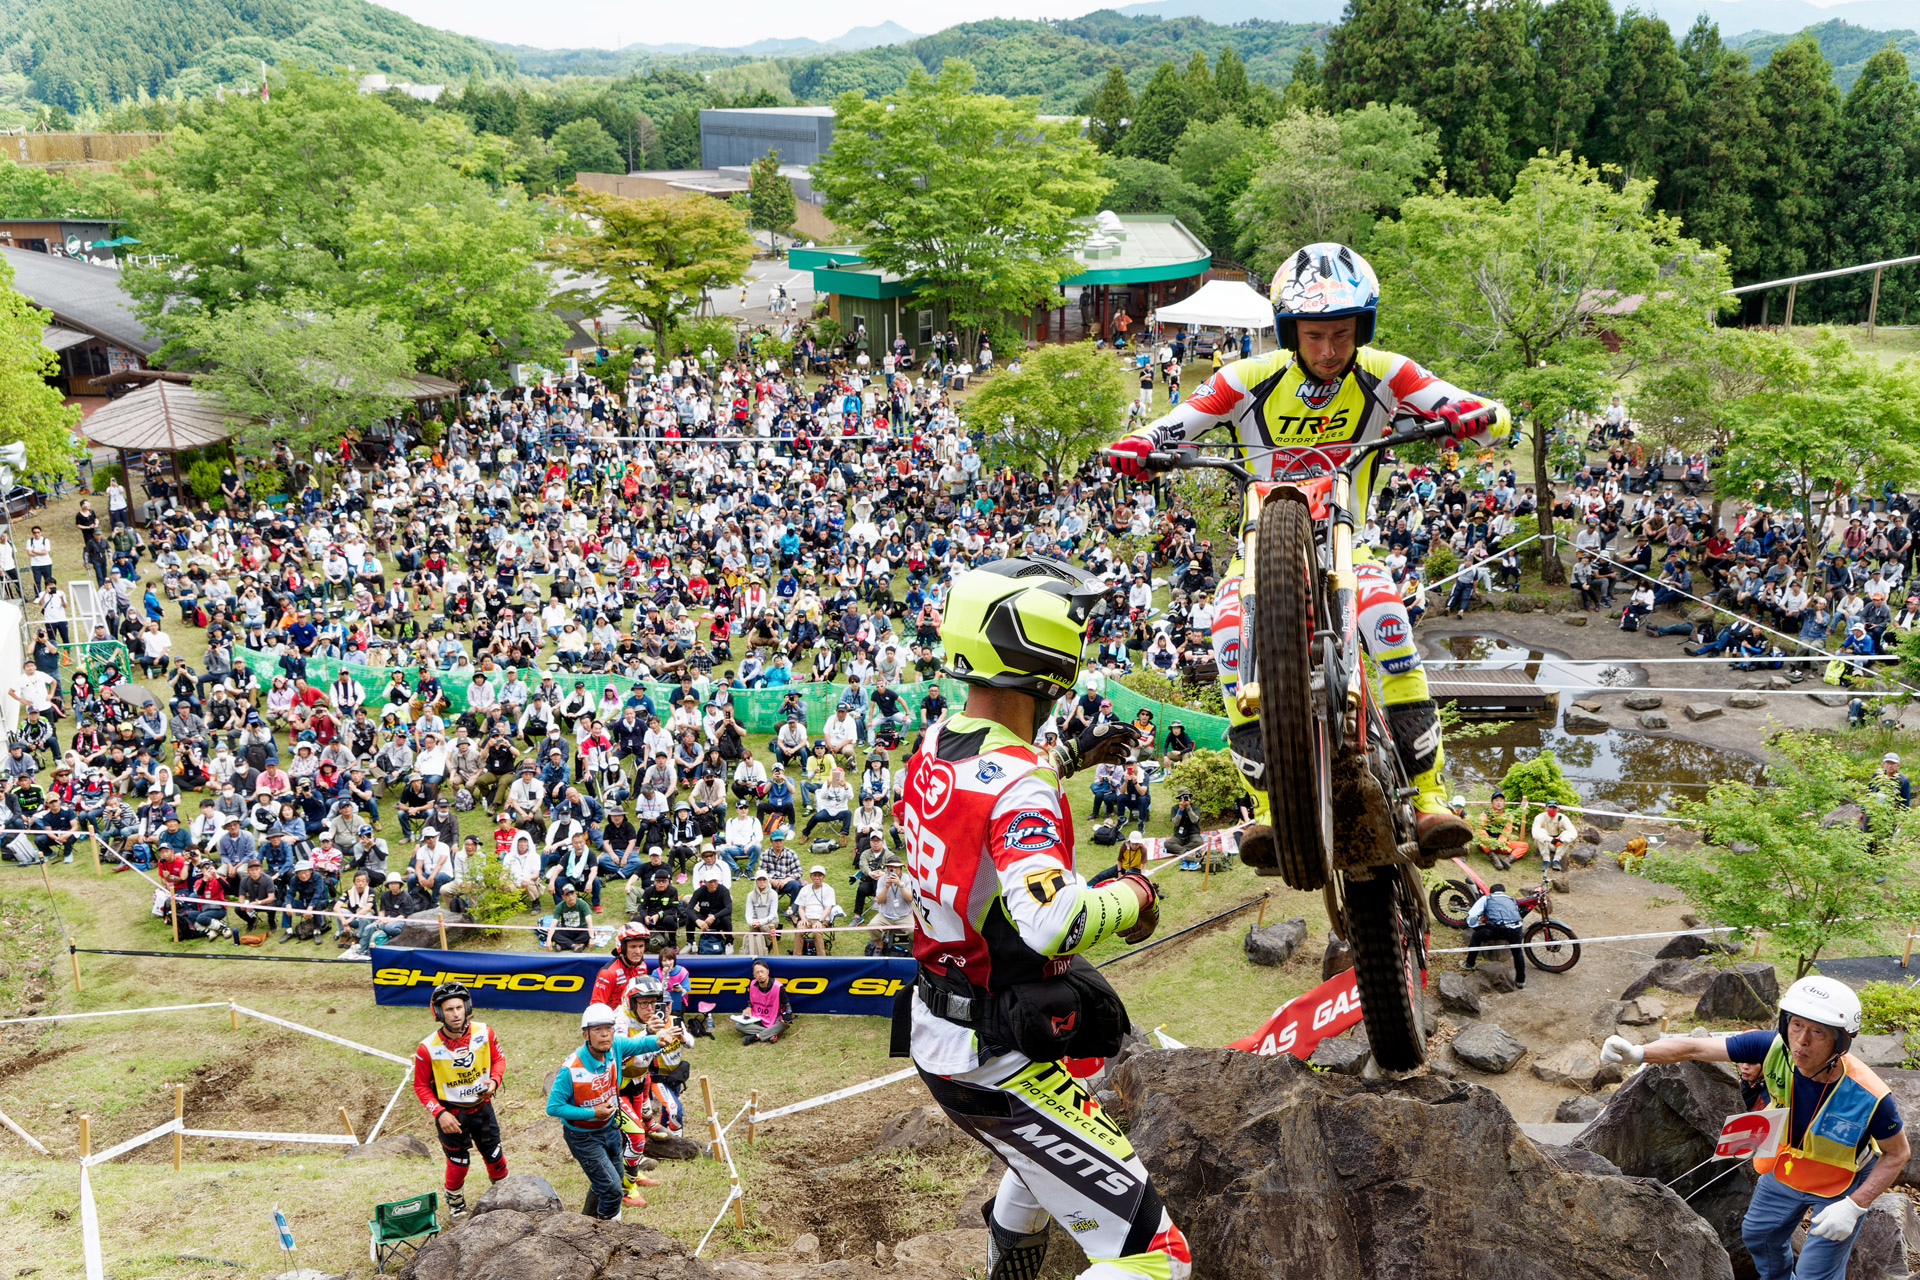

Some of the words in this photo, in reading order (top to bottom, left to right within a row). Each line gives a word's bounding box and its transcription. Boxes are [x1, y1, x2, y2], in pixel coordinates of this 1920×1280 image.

[1303, 294, 1328, 310] Red
[1329, 294, 1354, 306] Bull
[1274, 430, 1344, 443] MOTORCYCLES
[1003, 824, 1061, 849] NILS
[373, 968, 585, 993] SHERCO
[1808, 986, 1826, 998] Arai
[1251, 1020, 1298, 1056] AS
[446, 1071, 481, 1088] MANAGER
[457, 1067, 476, 1078] TEAM
[460, 1084, 483, 1098] Hertz
[1019, 1080, 1118, 1146] MOTORCYCLES
[1011, 1122, 1136, 1196] MOTS
